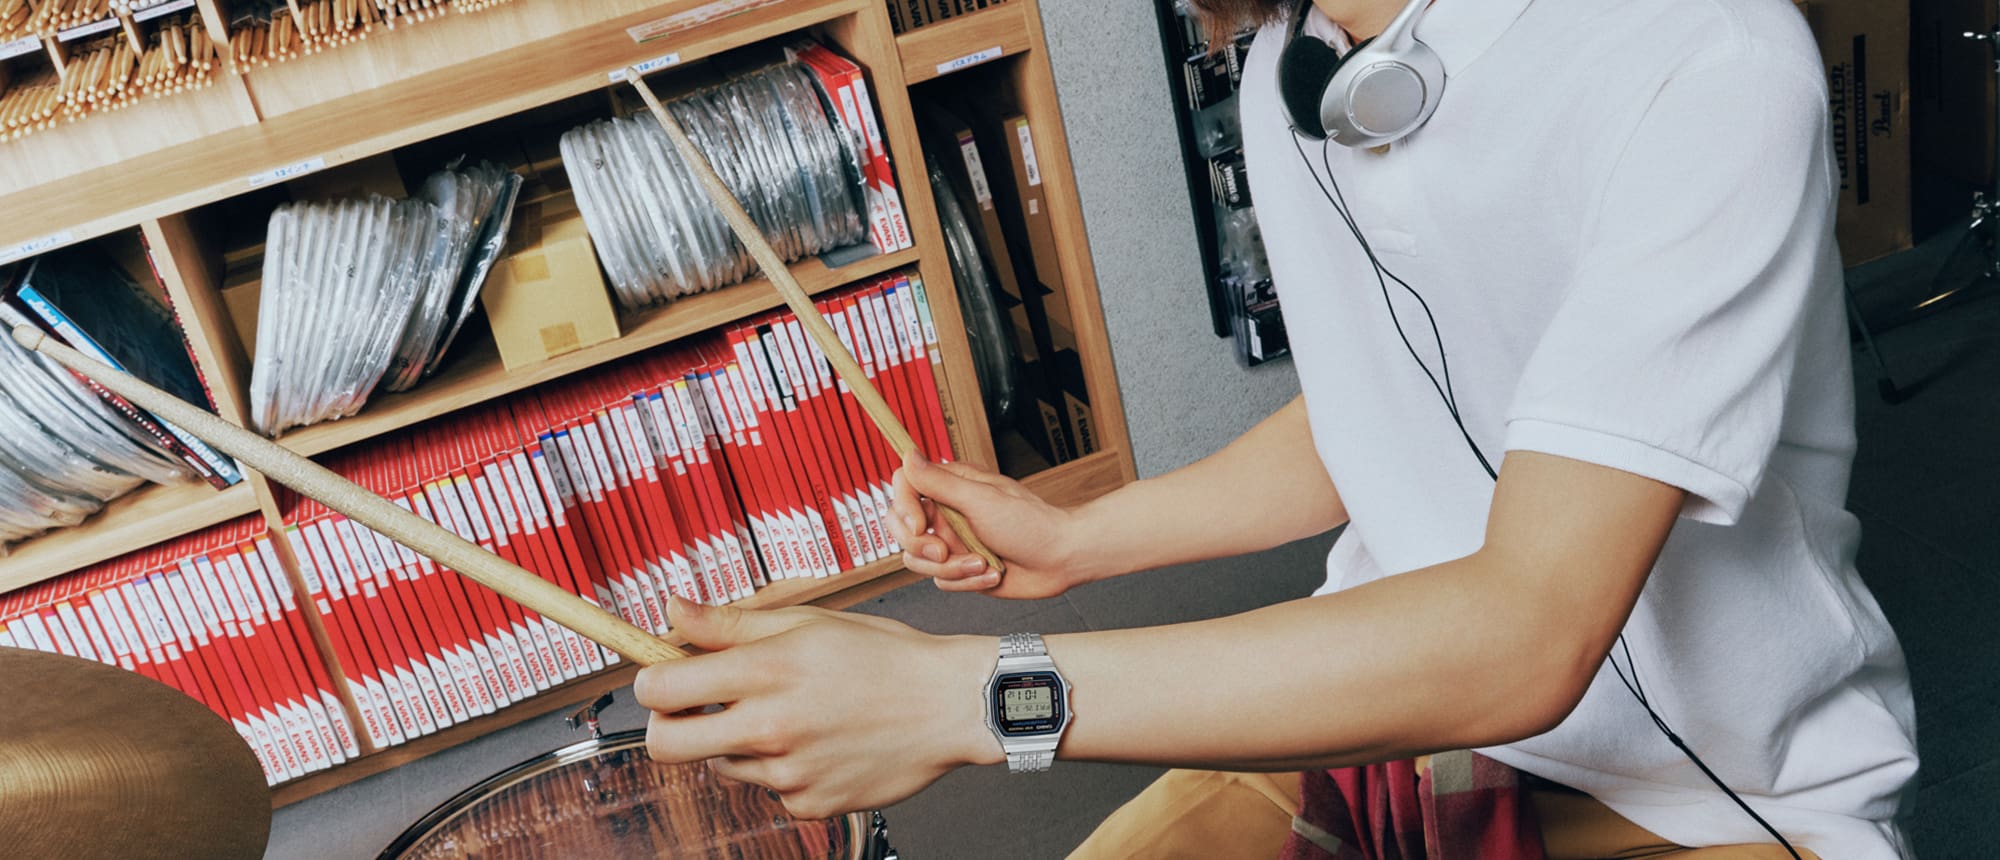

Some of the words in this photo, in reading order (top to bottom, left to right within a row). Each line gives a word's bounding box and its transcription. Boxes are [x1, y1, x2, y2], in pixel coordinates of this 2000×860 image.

[1224, 166, 1238, 194] YAMAHA
[880, 218, 894, 247] EVANS
[893, 214, 907, 244] EVANS
[845, 528, 860, 558] EVANS
[856, 524, 870, 554] EVANS
[870, 520, 884, 550] EVANS
[746, 550, 760, 580] EVANS
[762, 544, 778, 572] EVANS
[777, 541, 792, 570] EVANS
[792, 541, 806, 570] EVANS
[806, 540, 820, 570] EVANS
[820, 537, 834, 566] EVANS
[695, 572, 711, 602] EVANS
[710, 569, 725, 598] EVANS
[721, 563, 737, 593] EVANS
[734, 560, 750, 589] EVANS
[646, 597, 662, 626] EVANS
[540, 647, 558, 676] EVANS
[554, 641, 572, 671] EVANS
[568, 636, 584, 666] EVANS
[583, 637, 598, 662] VANS
[500, 664, 517, 693] EVANS
[513, 658, 530, 688] EVANS
[527, 652, 544, 682] EVANS
[444, 684, 462, 714] EVANS
[459, 678, 476, 708] EVANS
[472, 675, 489, 705] EVANS
[486, 669, 504, 700] EVANS
[396, 700, 414, 730] EVANS
[411, 696, 428, 726] EVANS
[428, 690, 446, 720] EVANS
[335, 720, 352, 750] EVANS
[364, 709, 382, 740] EVANS
[380, 706, 398, 736] EVANS
[279, 738, 297, 769] EVANS
[292, 733, 310, 764] EVANS
[305, 730, 324, 760] EVANS
[320, 726, 338, 756] EVANS
[264, 744, 282, 774] EVANS
